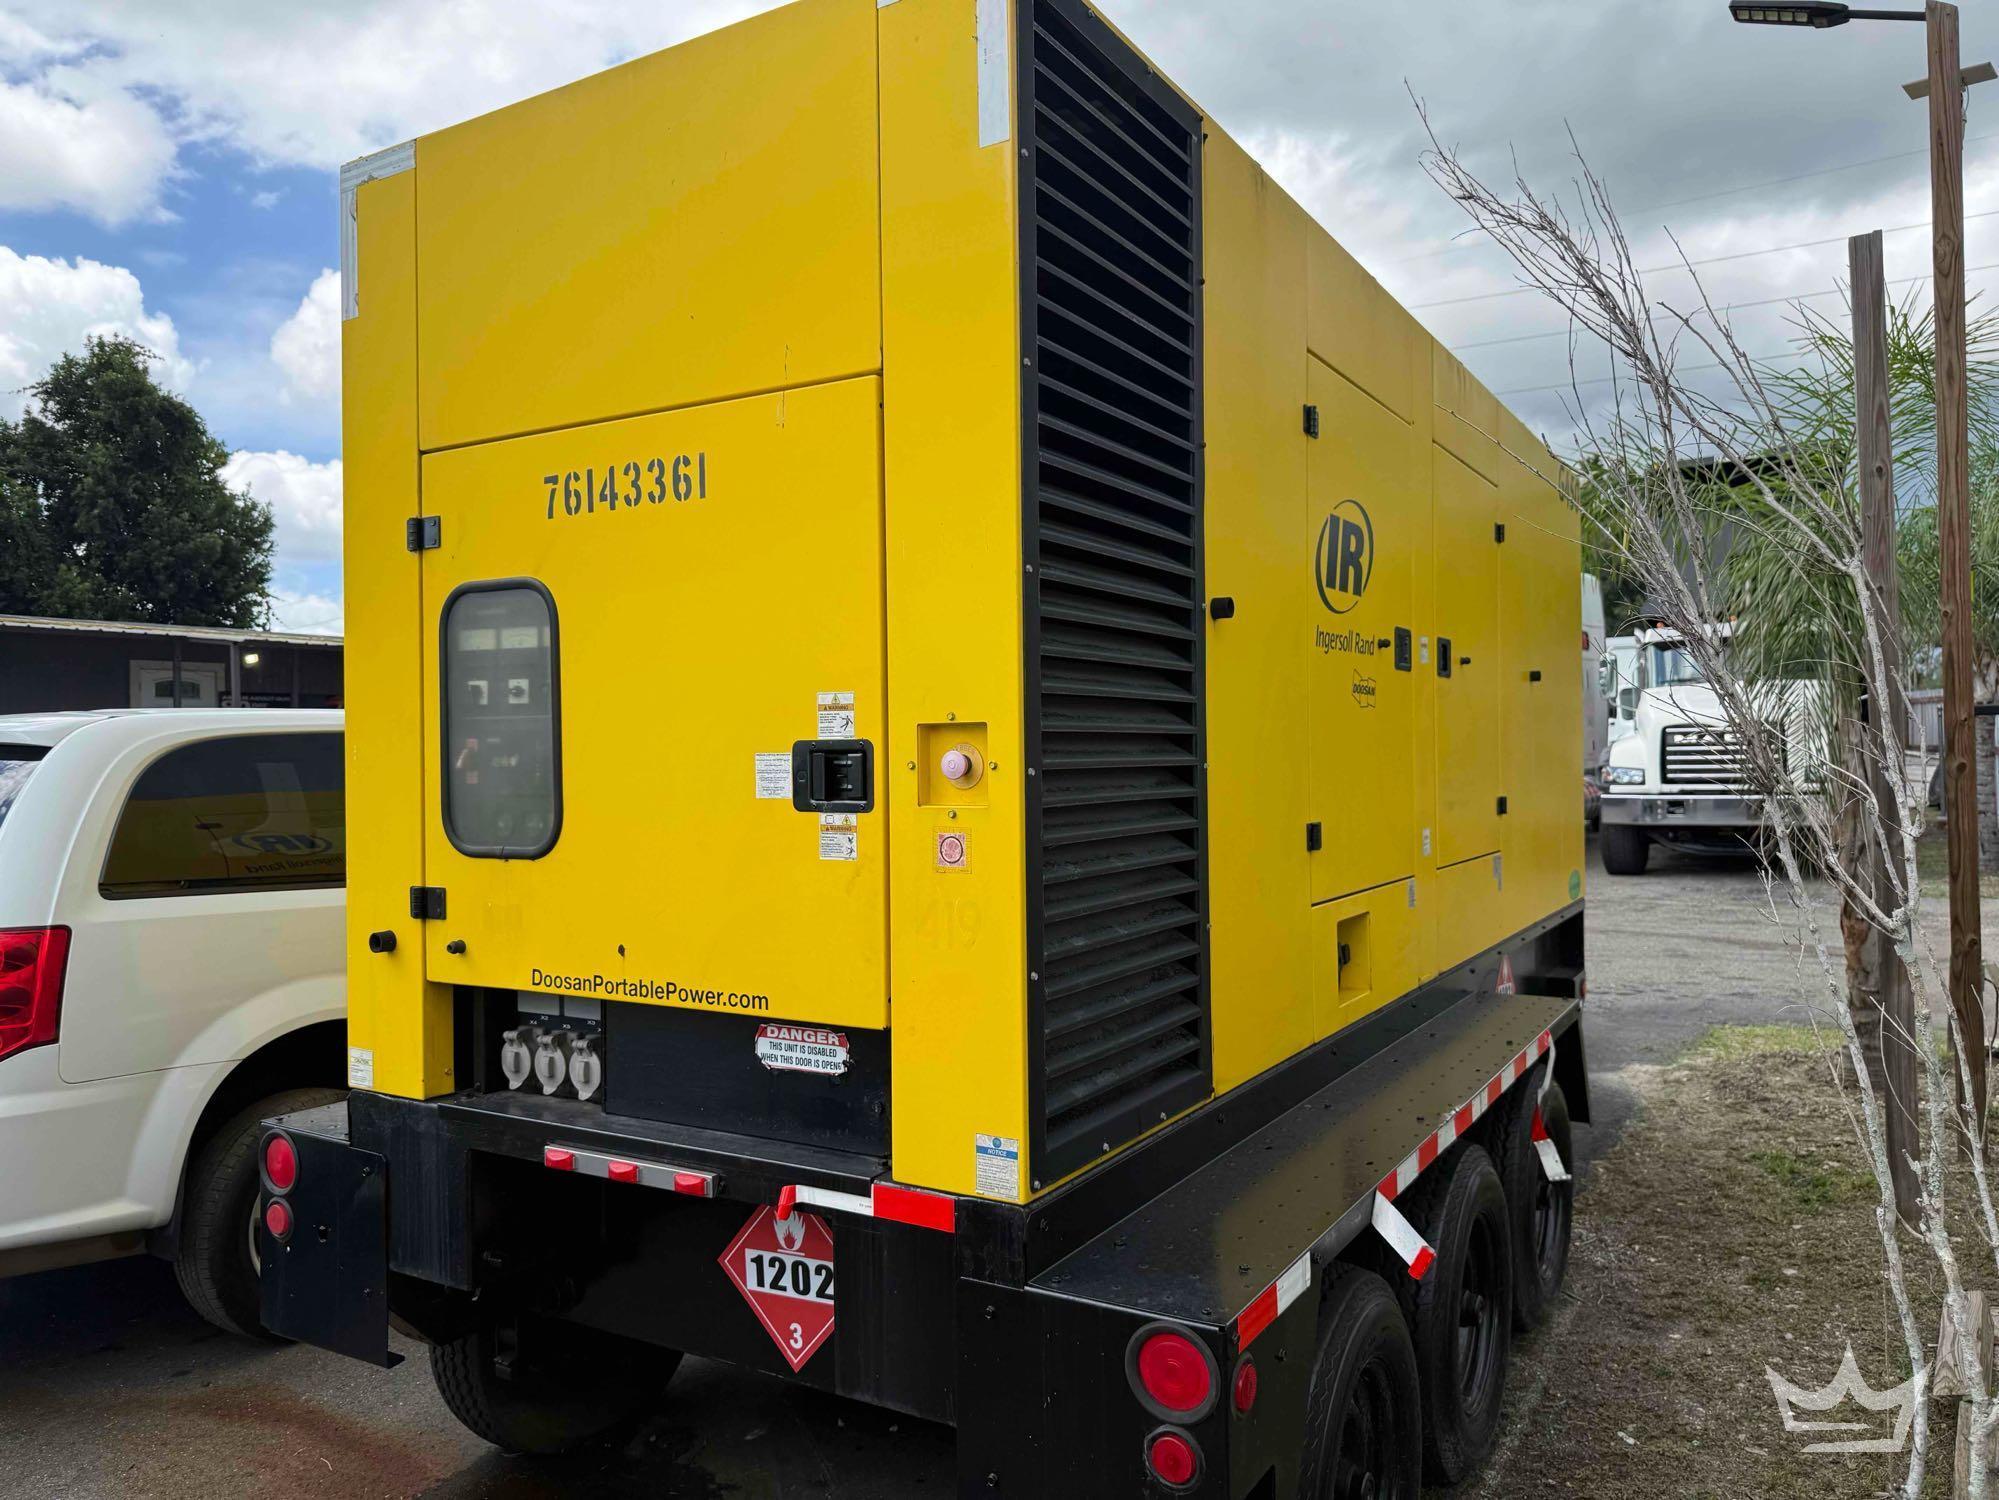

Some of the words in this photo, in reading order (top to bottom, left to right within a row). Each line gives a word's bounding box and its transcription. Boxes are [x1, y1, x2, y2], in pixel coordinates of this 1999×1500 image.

[544, 452, 706, 519] 76143361
[1326, 514, 1364, 597] IR
[1316, 625, 1353, 654] Ingersoll
[1355, 633, 1375, 656] Rand
[1353, 684, 1375, 696] DOOSAN
[531, 968, 769, 1010] DoosanPortablePower.com
[767, 1026, 839, 1045] DANGER
[761, 1052, 779, 1063] WHEN
[780, 1054, 794, 1065] THIS
[795, 1058, 813, 1068] DOOR
[813, 1060, 820, 1069] IS
[769, 1042, 782, 1051] THIS
[784, 1043, 799, 1053] UNIT
[800, 1046, 806, 1055] IS
[807, 1047, 837, 1058] DISABLED
[988, 1148, 1007, 1157] NOTICE
[751, 1254, 833, 1299] 1202
[789, 1322, 803, 1349] 3
